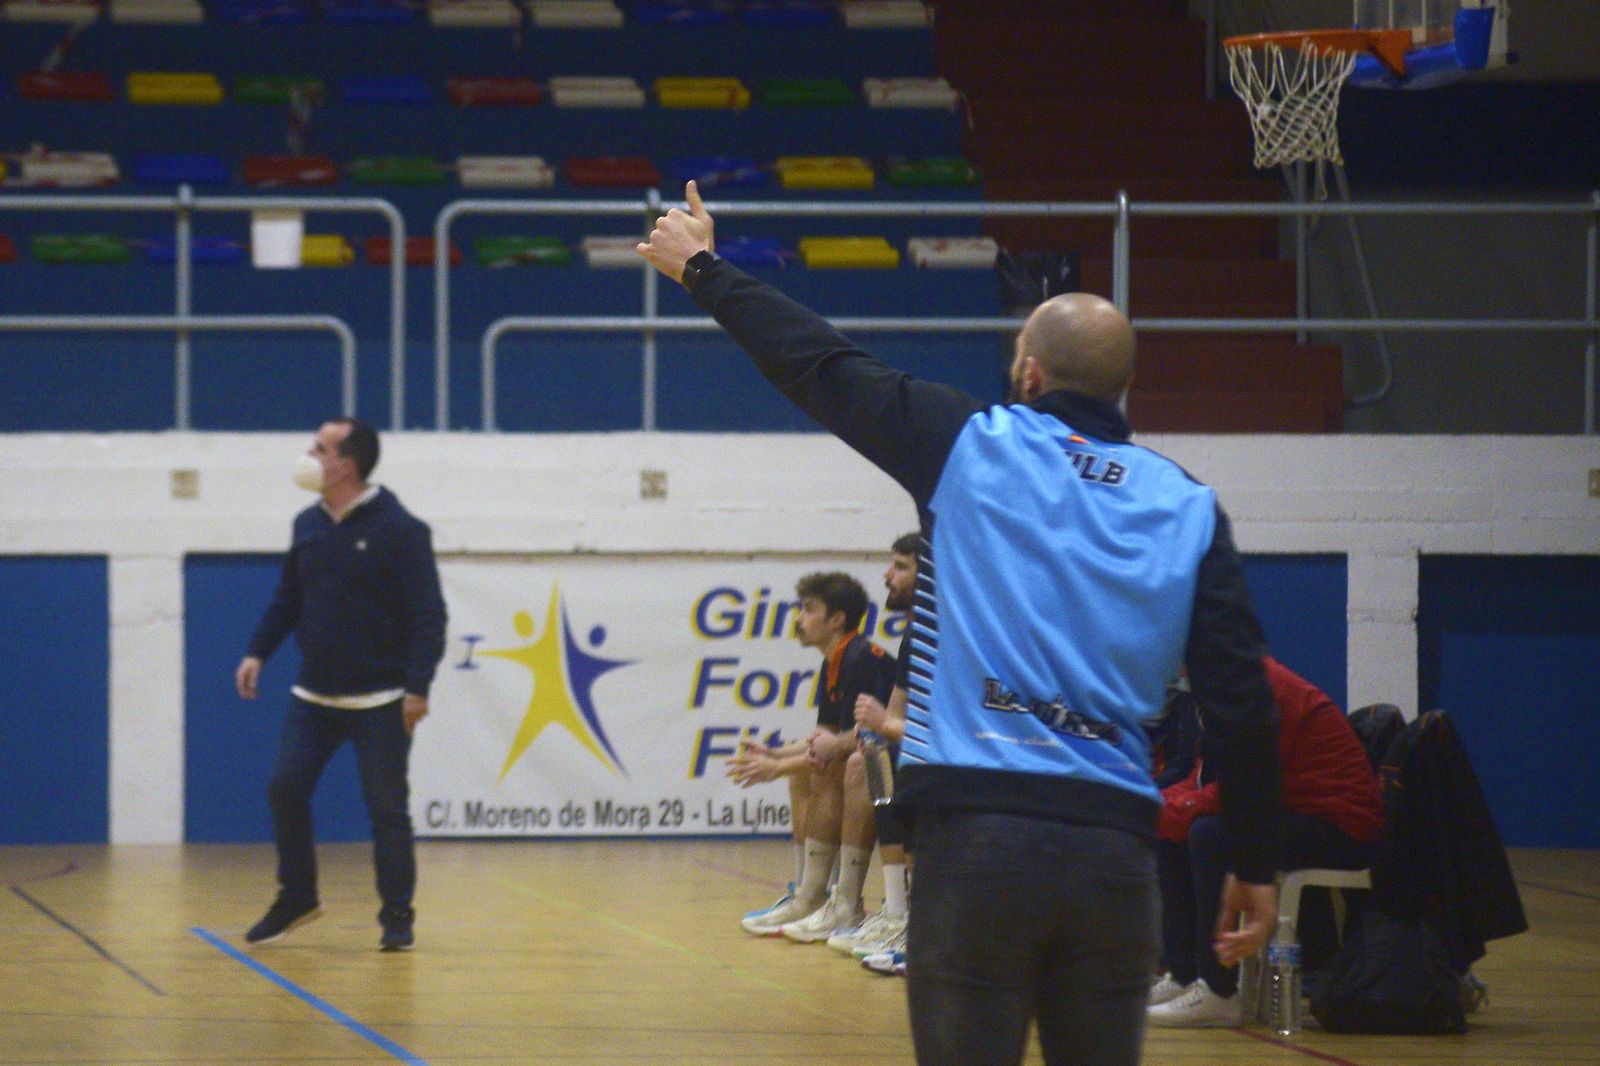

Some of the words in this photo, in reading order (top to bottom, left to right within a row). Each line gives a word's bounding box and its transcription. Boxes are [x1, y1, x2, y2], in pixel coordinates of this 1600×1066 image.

[688, 656, 822, 710] For
[464, 801, 551, 828] Moreno
[559, 800, 587, 828] de
[594, 799, 650, 828] Mora
[658, 799, 684, 827] 29
[707, 799, 734, 827] La
[742, 798, 791, 828] Líne
